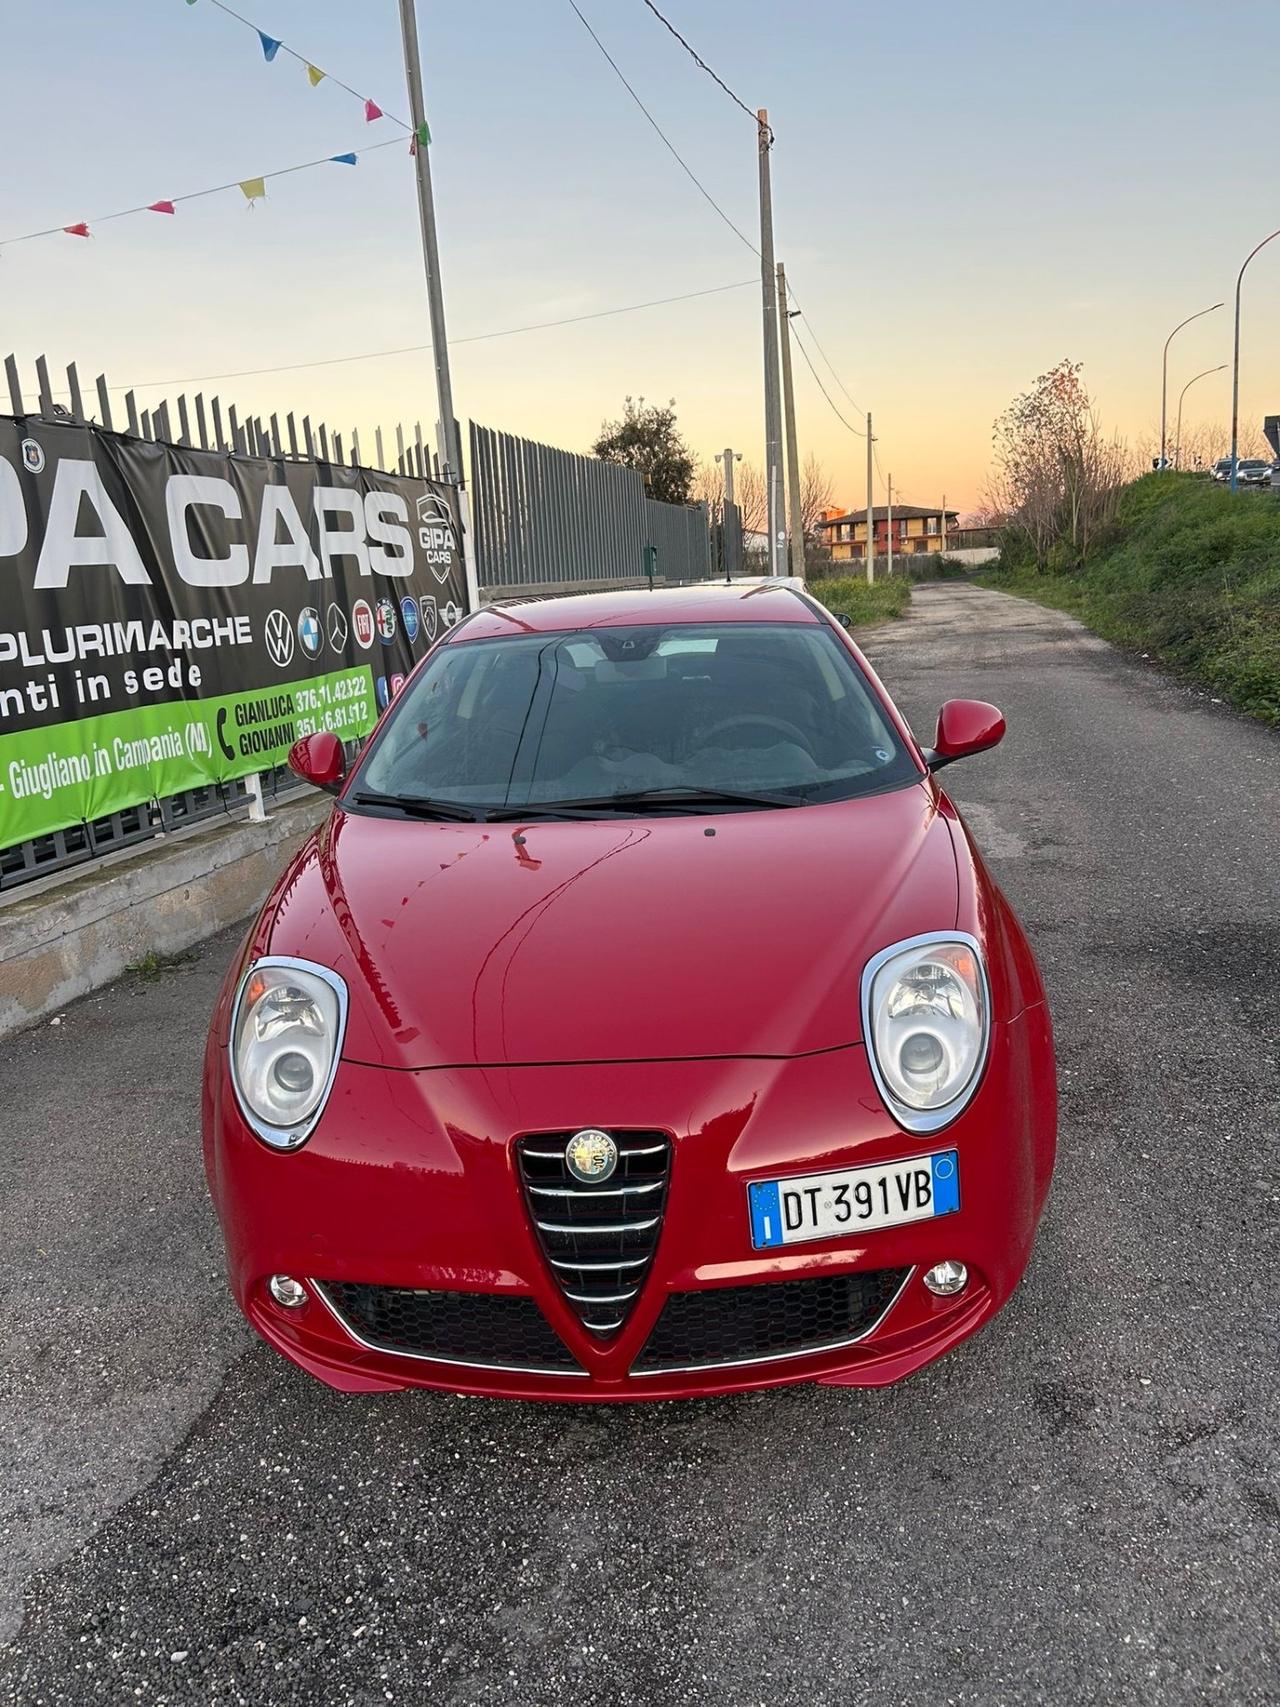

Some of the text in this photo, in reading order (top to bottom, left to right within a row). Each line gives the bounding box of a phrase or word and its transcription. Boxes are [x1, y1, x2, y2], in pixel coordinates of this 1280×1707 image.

[165, 474, 414, 587] CARS
[419, 527, 455, 550] GIPA
[427, 551, 451, 564] CARS
[75, 670, 111, 703] in
[124, 658, 202, 695] sede
[235, 694, 295, 727] GIANLUCA
[239, 721, 295, 756] GIOVANNI
[8, 752, 91, 800] Giugliano
[93, 743, 112, 776] in
[113, 726, 184, 771] Campania
[783, 1187, 822, 1231] DT
